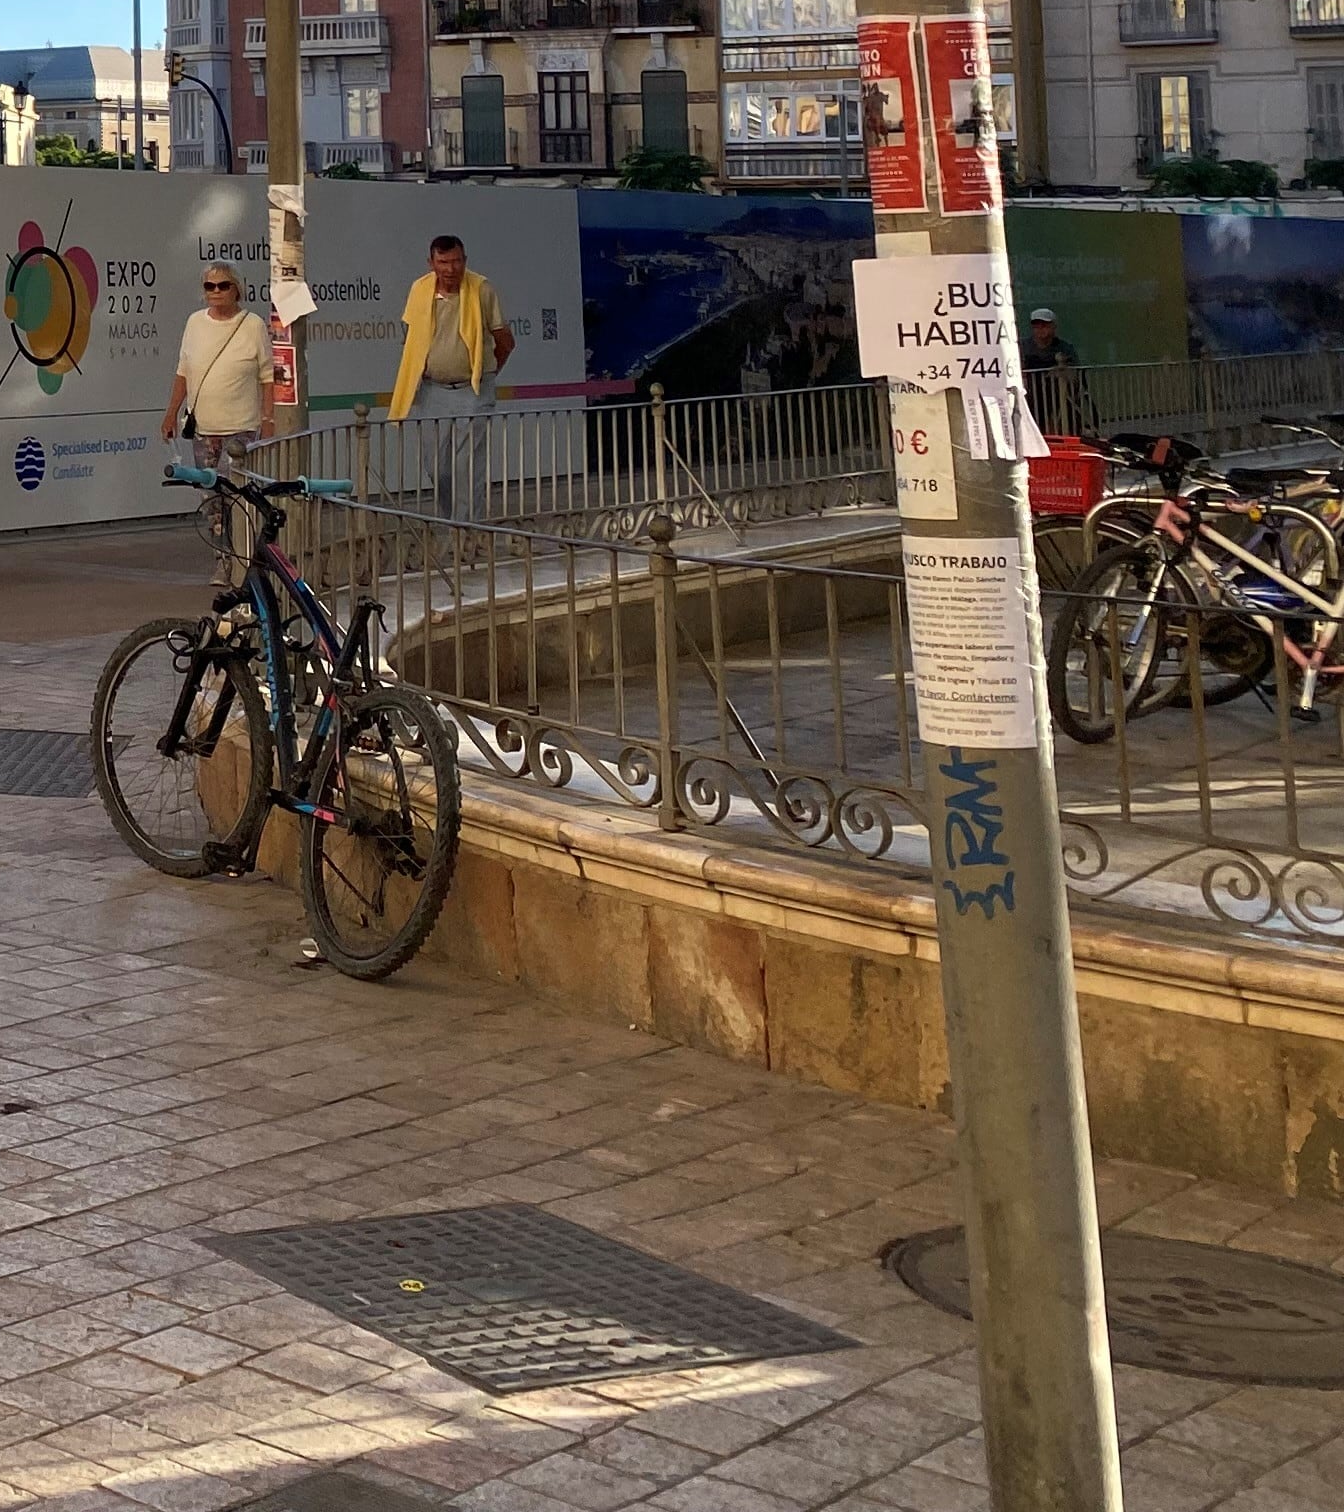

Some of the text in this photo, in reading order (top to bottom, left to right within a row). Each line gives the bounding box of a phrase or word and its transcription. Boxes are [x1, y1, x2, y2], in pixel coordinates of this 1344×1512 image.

[198, 236, 216, 261] La
[220, 243, 243, 261] era
[106, 261, 157, 287] EXPO
[311, 276, 381, 302] sostenible
[107, 295, 157, 314] 2027
[306, 312, 396, 342] innovación
[917, 364, 952, 380] +34
[956, 357, 1002, 379] 744
[52, 436, 147, 459] Specialised Expo 2027
[52, 463, 94, 480] Candidate
[912, 478, 938, 492] 718
[940, 556, 1007, 569] TRABAJO
